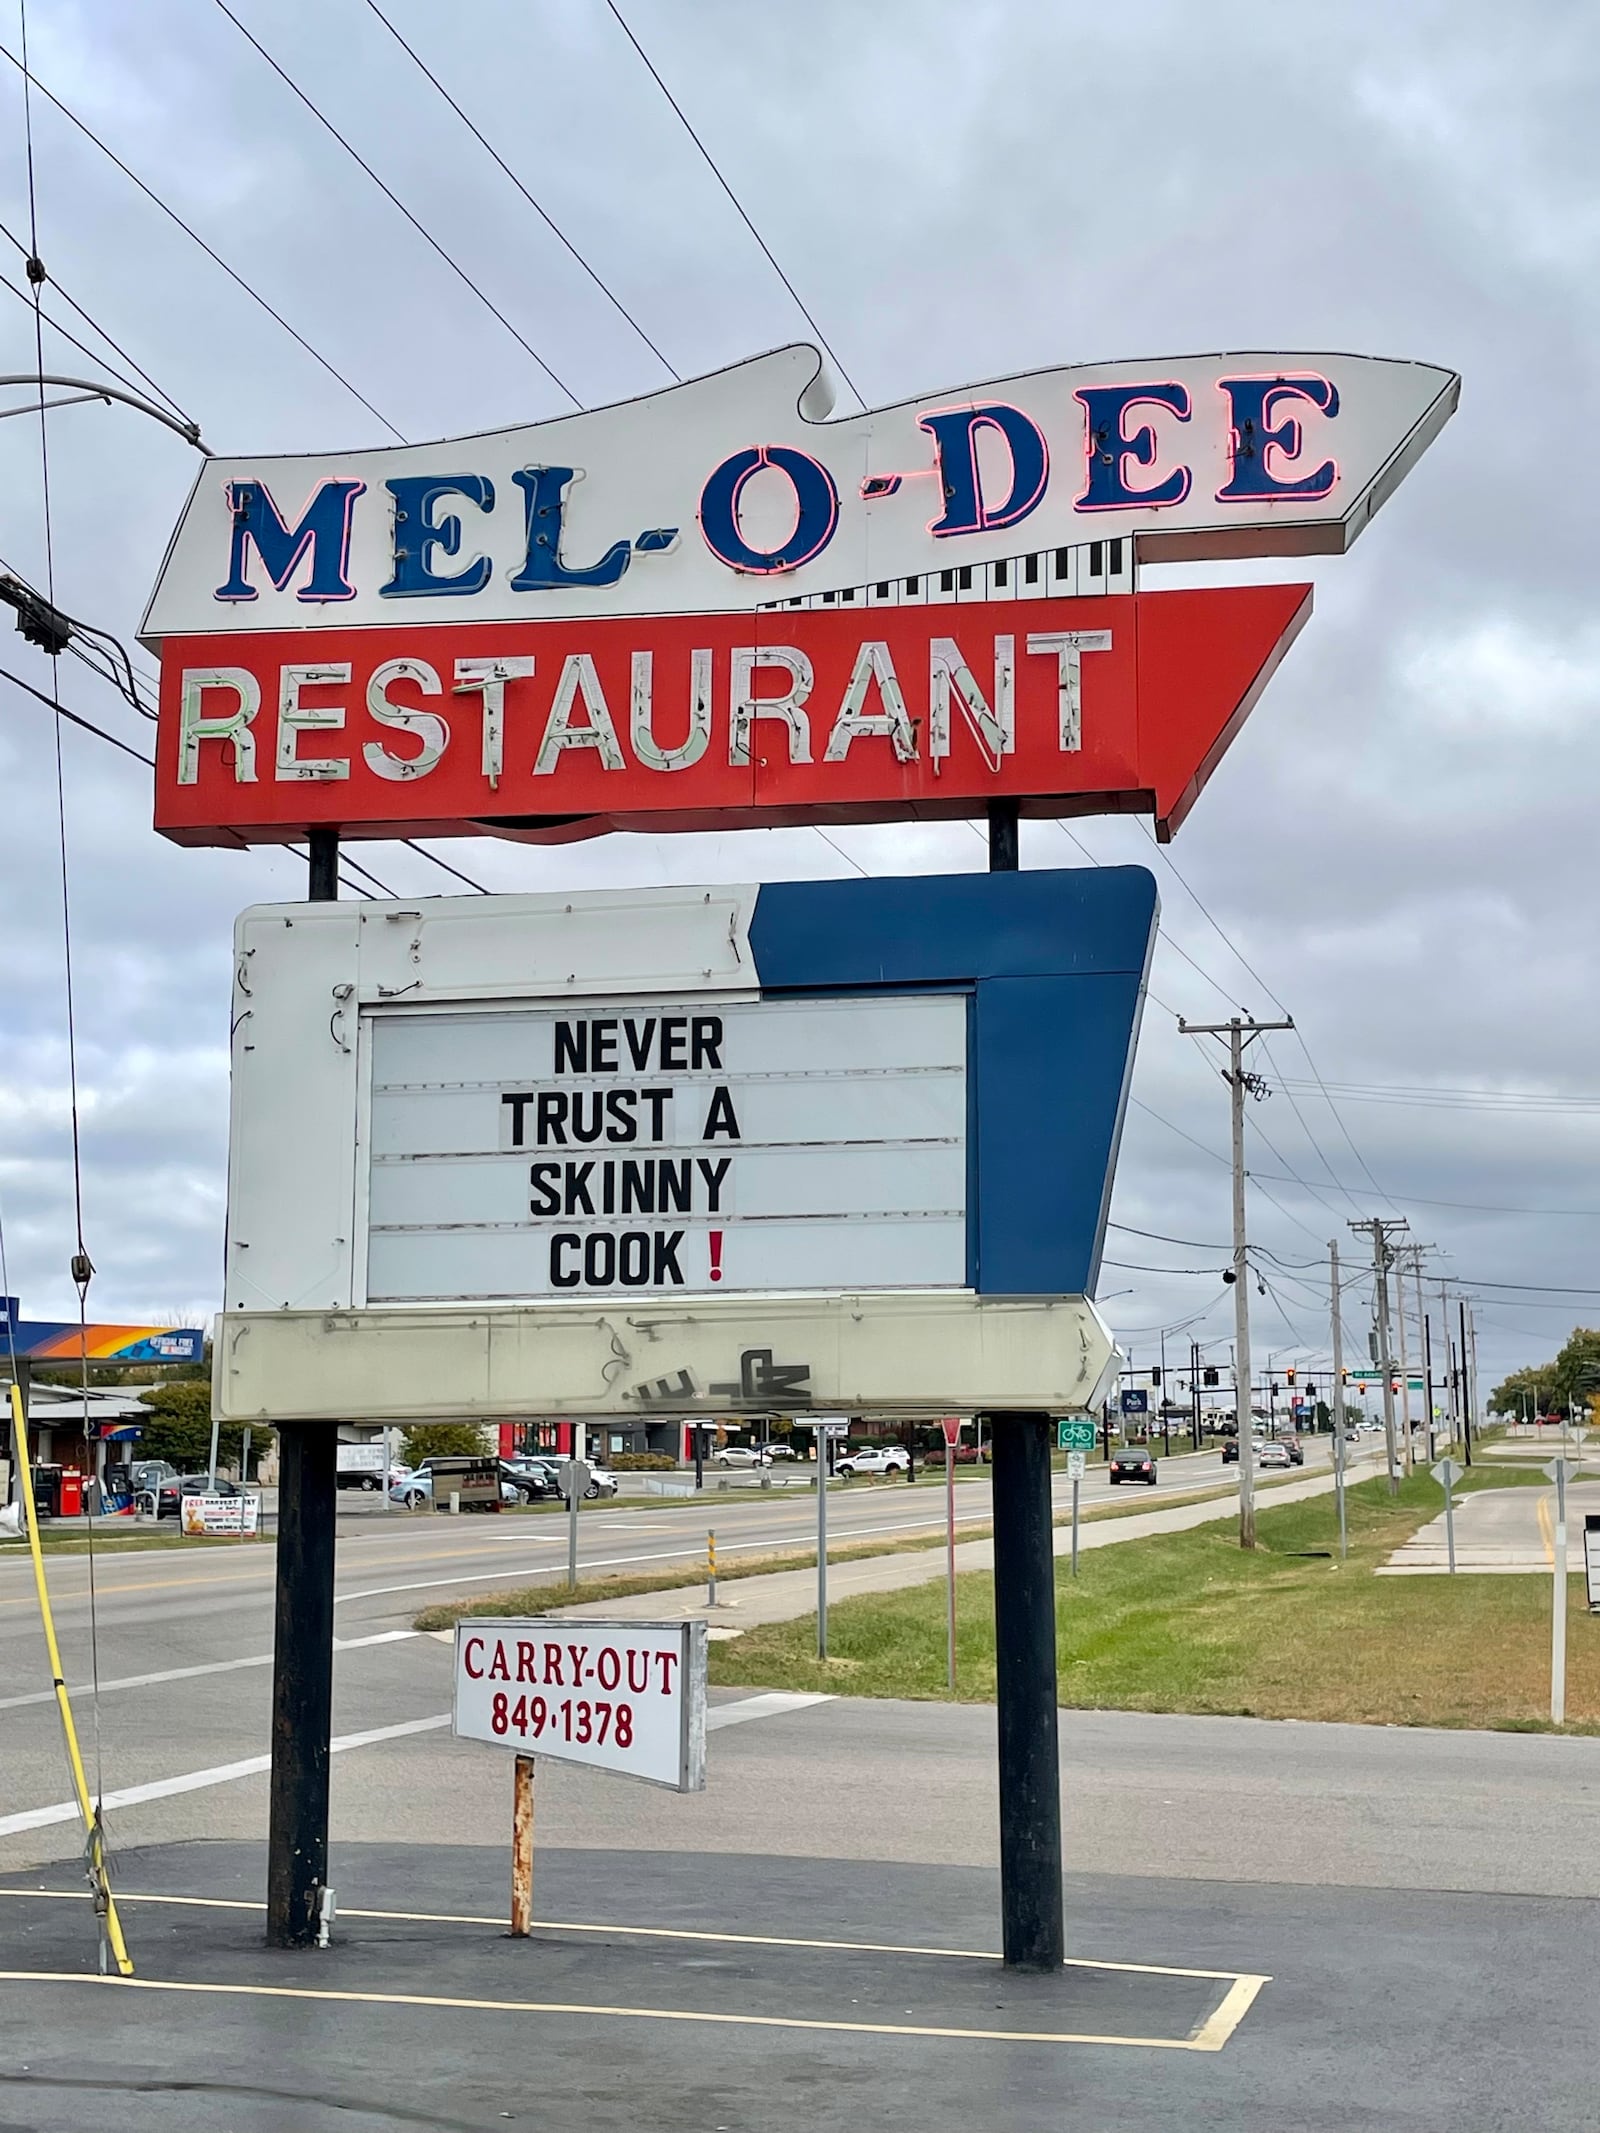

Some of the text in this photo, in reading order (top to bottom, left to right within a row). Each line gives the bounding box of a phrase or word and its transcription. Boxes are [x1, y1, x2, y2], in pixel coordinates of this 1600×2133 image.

[177, 629, 1113, 787] RESTAURANT
[554, 1016, 723, 1074] NEVER
[501, 1086, 741, 1146] TRUST A
[530, 1158, 732, 1216] SKINNY
[464, 1637, 678, 1695] CARRY-OUT
